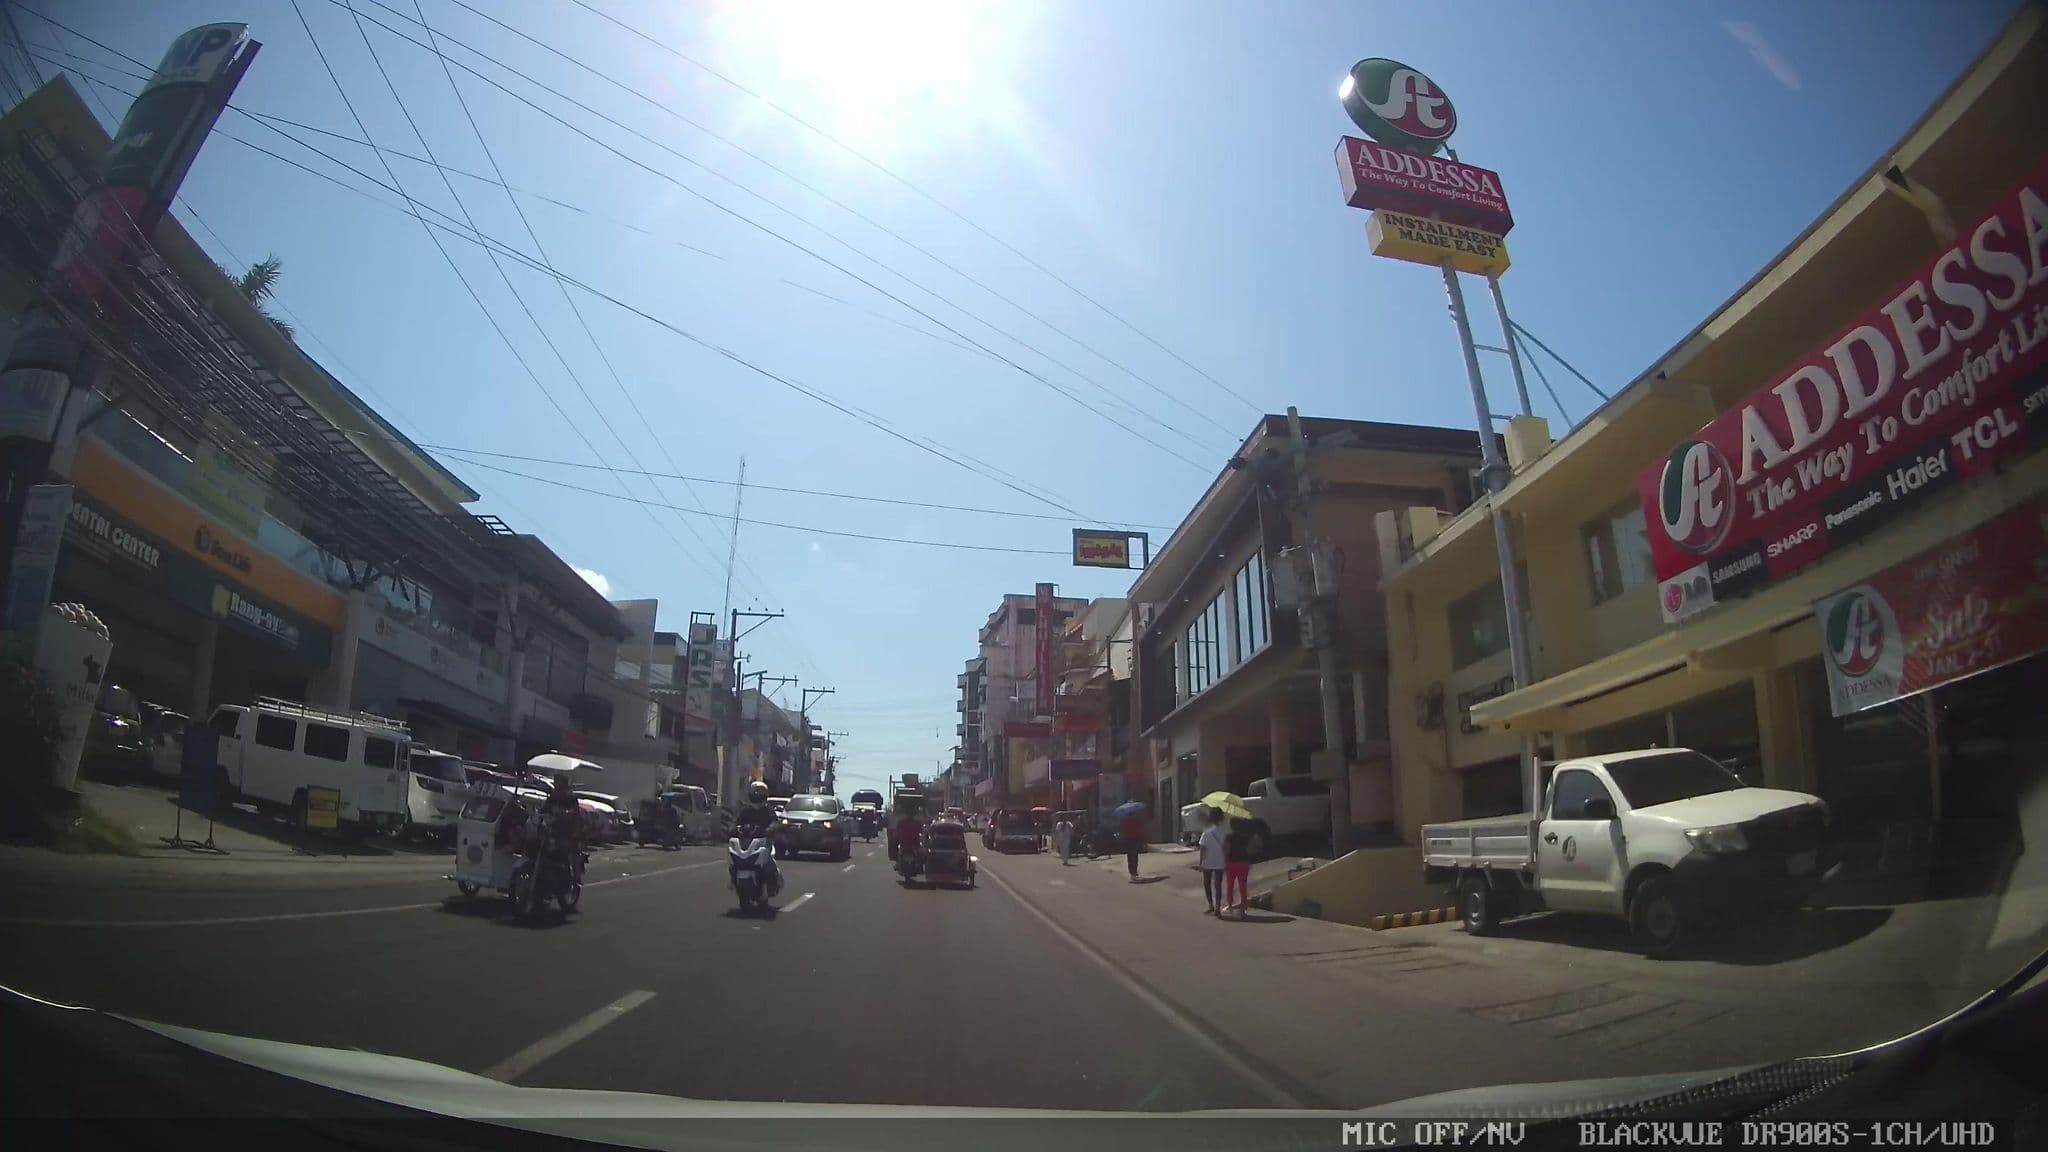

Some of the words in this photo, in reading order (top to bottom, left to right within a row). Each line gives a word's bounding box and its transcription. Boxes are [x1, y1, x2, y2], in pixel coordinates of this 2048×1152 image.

[1356, 145, 1502, 198] ADDESSA
[1359, 168, 1383, 180] The
[1384, 173, 1409, 188] Way
[1412, 179, 1426, 190] To
[1428, 183, 1471, 200] Comfort
[1384, 213, 1505, 248] INSTALLMENT
[1398, 227, 1451, 249] MADE
[1452, 239, 1496, 258] EASY
[1746, 477, 1798, 519] The
[1794, 442, 1854, 491] Way
[1858, 416, 1899, 454] To
[1901, 326, 2015, 425] Comfort
[1951, 407, 2019, 460] TCL
[1886, 449, 1949, 500] Haier
[1825, 490, 1883, 530] Panasonic
[1766, 523, 1819, 558] SHARP
